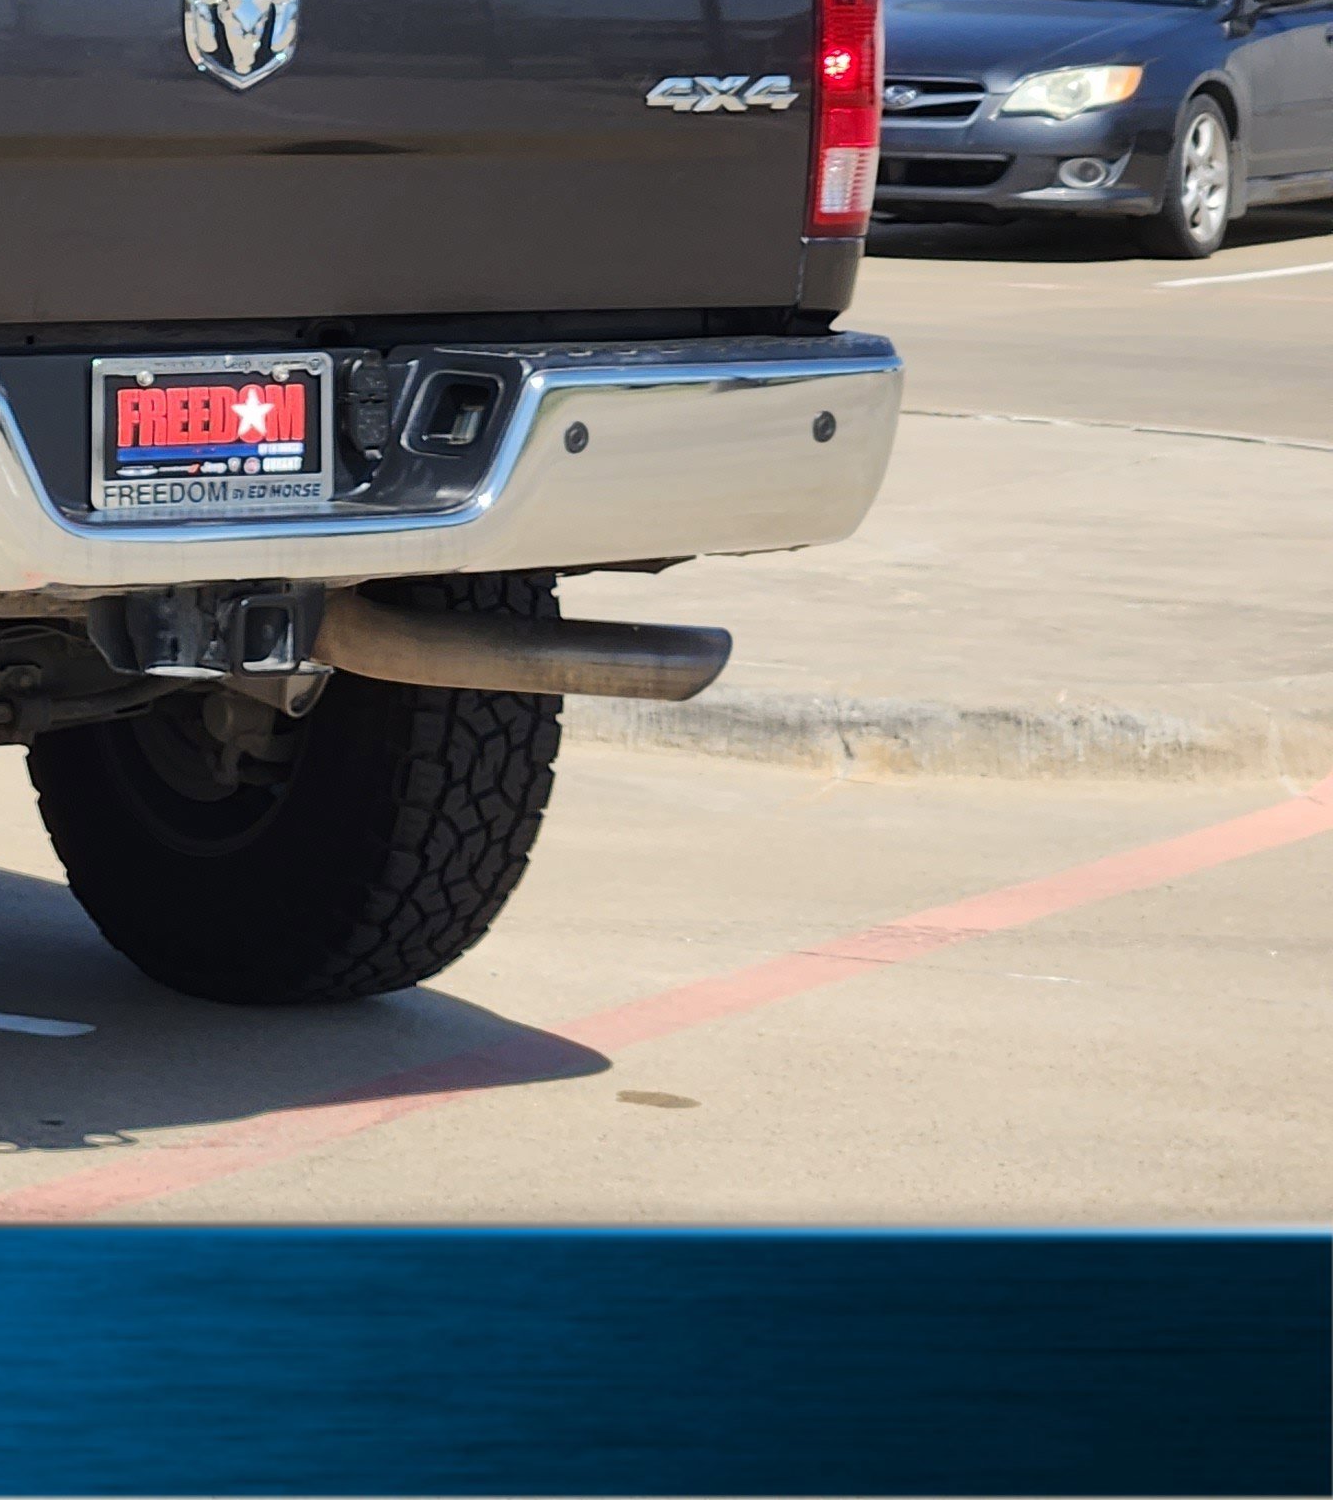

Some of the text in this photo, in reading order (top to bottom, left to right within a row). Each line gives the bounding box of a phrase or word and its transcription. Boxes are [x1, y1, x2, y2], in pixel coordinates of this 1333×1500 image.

[117, 383, 305, 447] FREEDOM
[102, 481, 228, 507] FREEDOM
[247, 484, 266, 498] ED
[269, 482, 322, 498] MORSE
